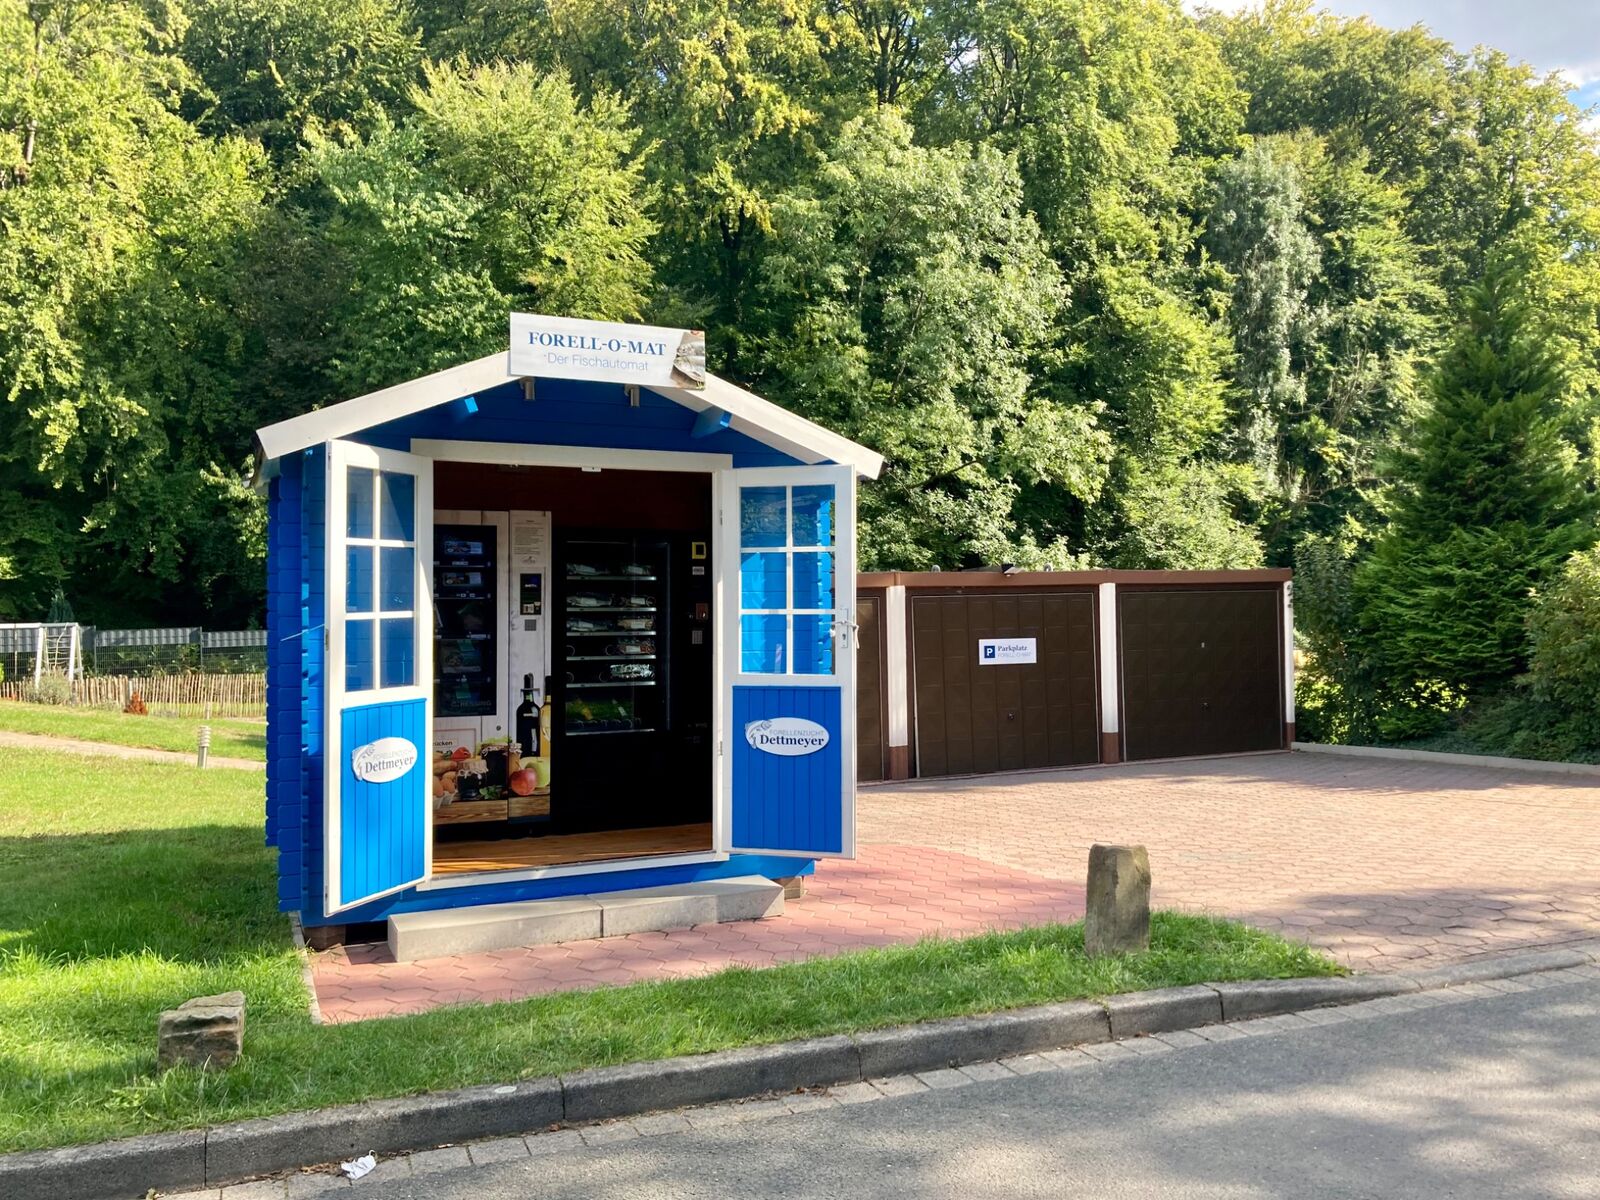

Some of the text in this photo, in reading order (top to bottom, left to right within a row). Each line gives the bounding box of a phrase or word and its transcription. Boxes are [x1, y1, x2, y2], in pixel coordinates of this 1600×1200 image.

[528, 331, 667, 356] FORELL-O-MAT
[547, 352, 649, 371] Der Fischautomat
[998, 645, 1028, 653] Parkplatz
[760, 734, 824, 748] Dettmeyer
[365, 757, 414, 773] Dettmeyer
